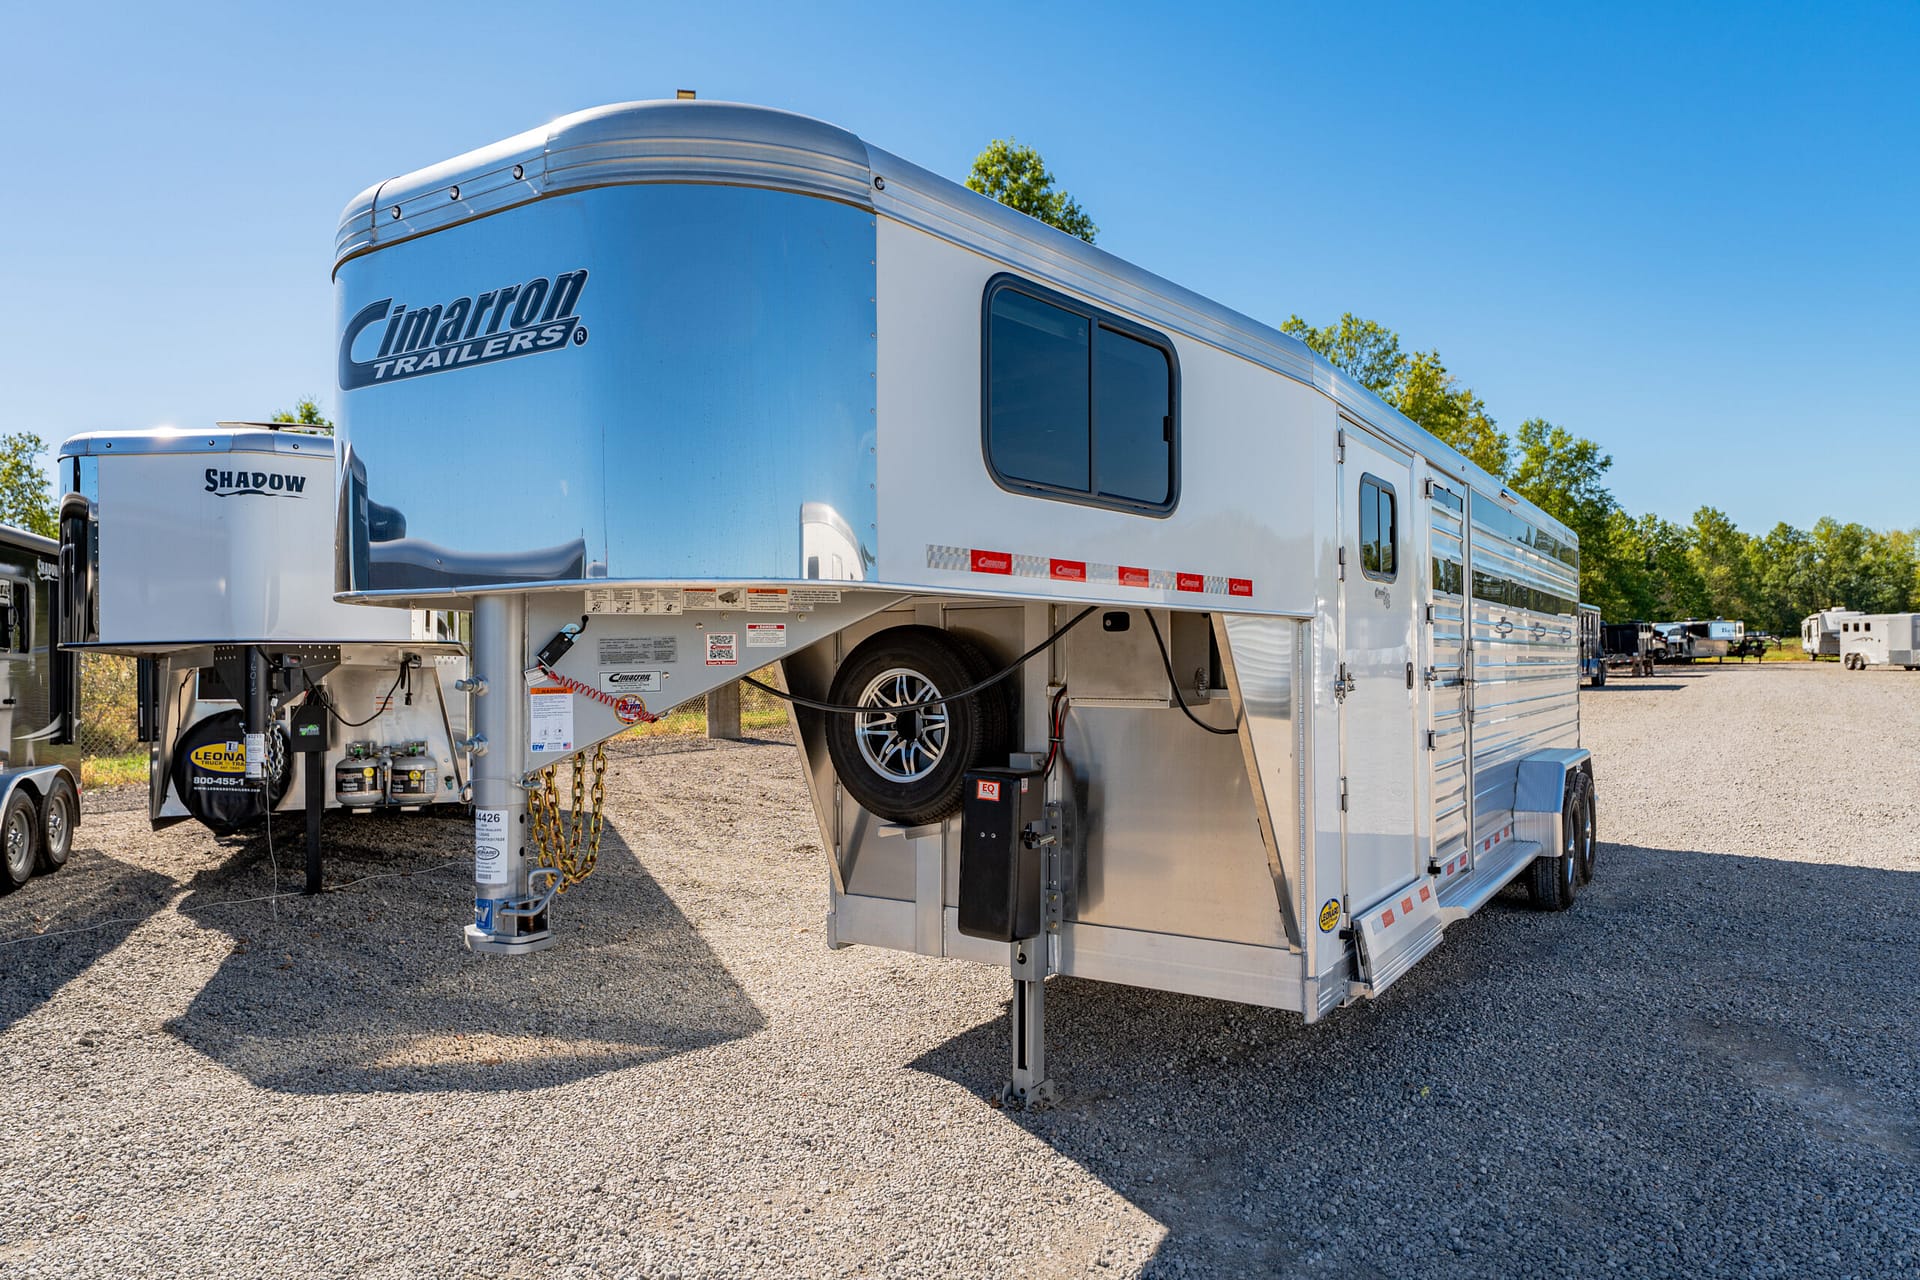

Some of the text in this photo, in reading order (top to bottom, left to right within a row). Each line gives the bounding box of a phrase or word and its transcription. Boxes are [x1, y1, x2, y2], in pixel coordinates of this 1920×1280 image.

[339, 269, 588, 391] Cimarron
[374, 325, 566, 379] TRAILERS
[204, 468, 306, 492] SHADOW
[195, 752, 245, 762] LEONA
[193, 776, 244, 786] 800-455-1
[982, 783, 995, 795] EQ
